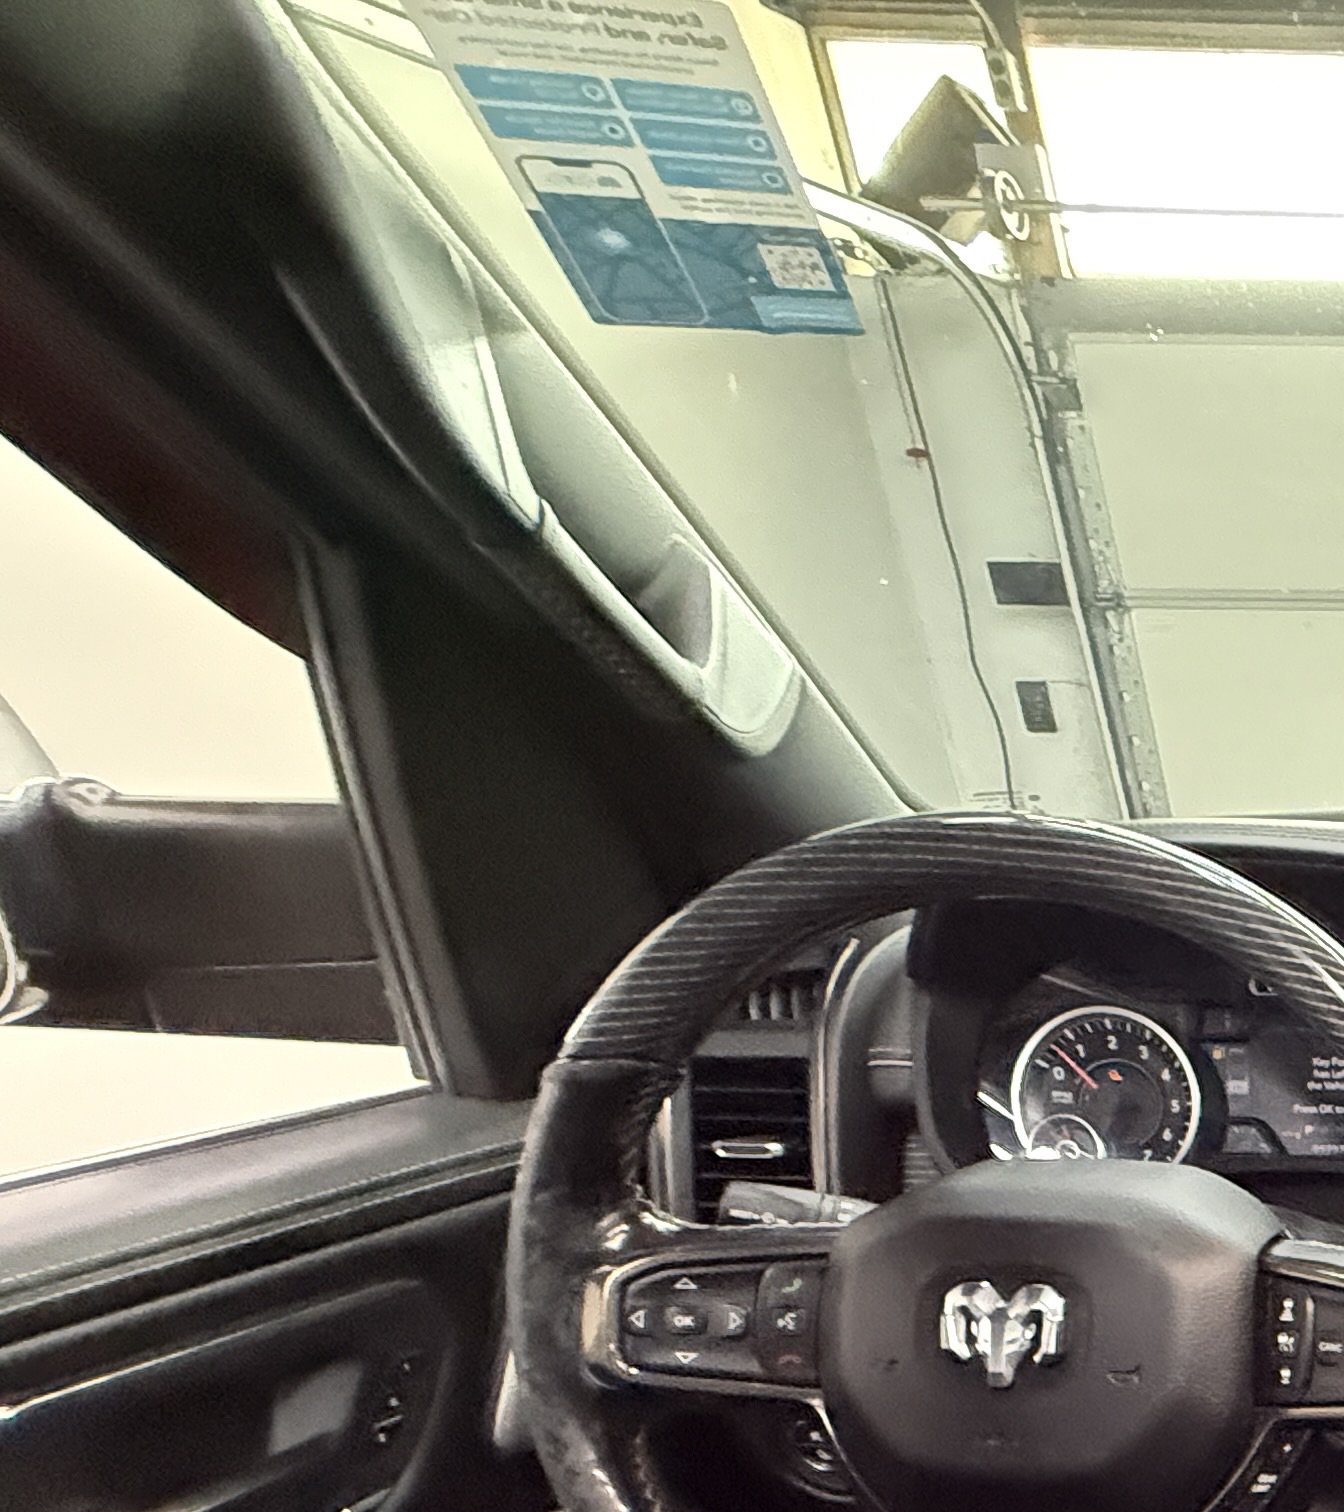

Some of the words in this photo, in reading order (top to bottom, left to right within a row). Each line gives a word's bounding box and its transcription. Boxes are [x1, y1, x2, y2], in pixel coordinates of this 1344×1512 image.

[1107, 1035, 1119, 1050] 2
[1052, 1066, 1065, 1081] 0
[673, 1315, 695, 1327] OK
